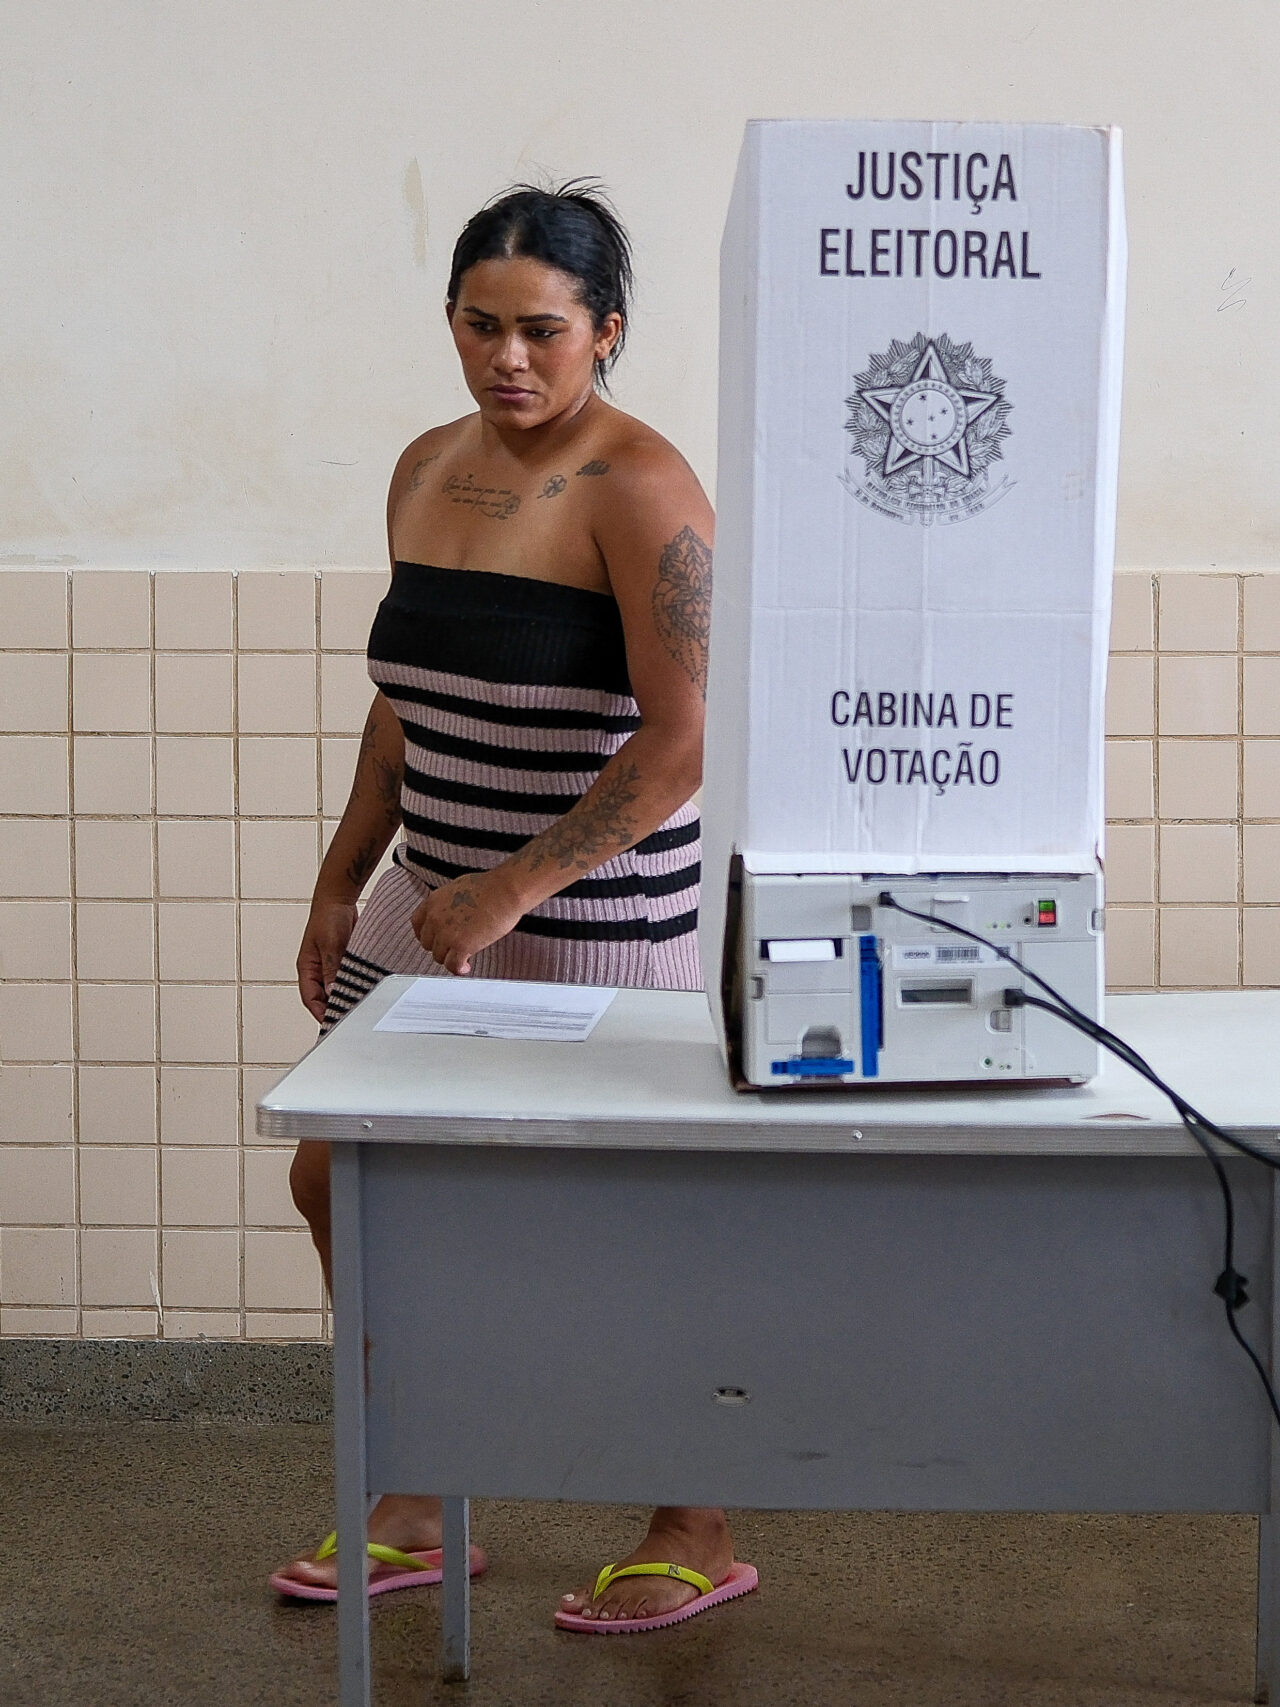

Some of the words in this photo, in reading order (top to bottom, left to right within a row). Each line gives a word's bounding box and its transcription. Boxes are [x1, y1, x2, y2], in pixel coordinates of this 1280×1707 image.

[846, 151, 1017, 215] JUSTIÇA
[820, 228, 1042, 280] ELEITORAL
[831, 690, 958, 728] CABINA
[970, 693, 1014, 728] DE
[842, 742, 1000, 796] VOTAÇÃO
